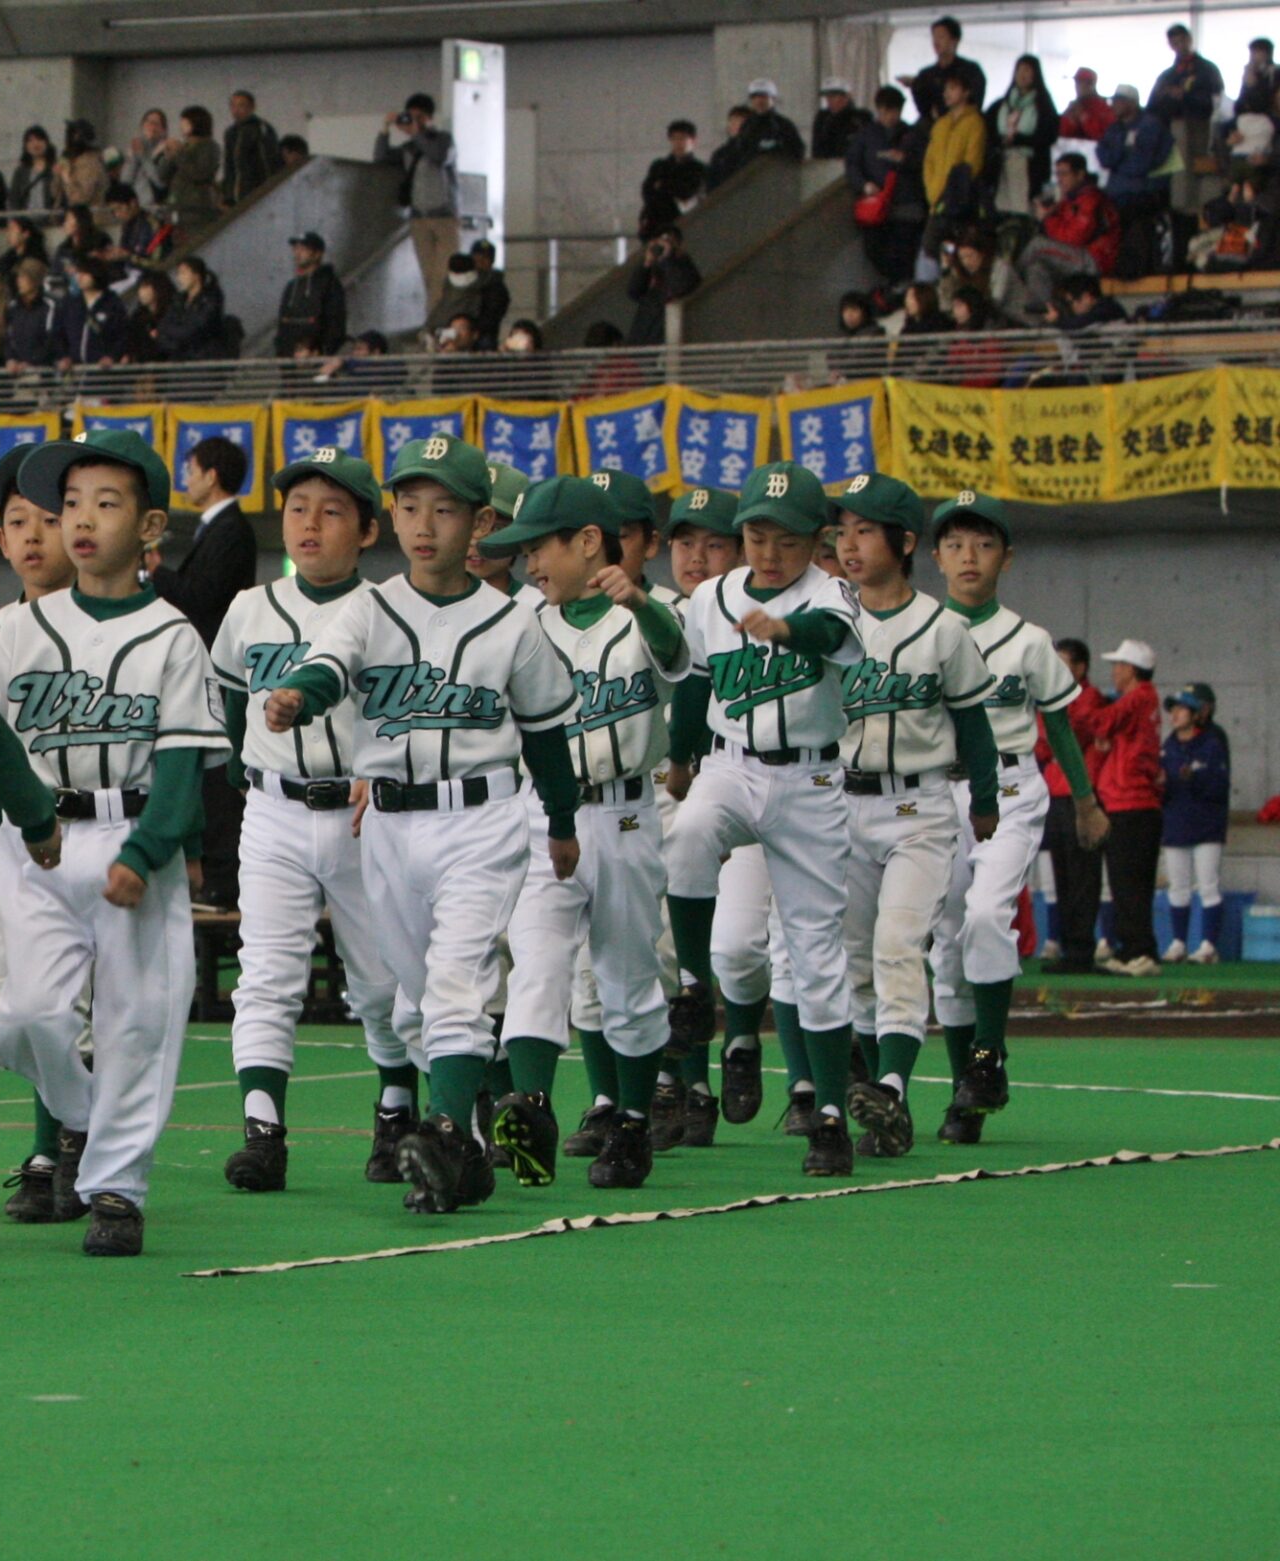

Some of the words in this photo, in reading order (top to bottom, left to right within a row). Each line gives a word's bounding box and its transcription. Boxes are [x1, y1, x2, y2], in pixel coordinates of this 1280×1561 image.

[687, 417, 747, 450] 交通
[1010, 432, 1104, 465] 交通安全
[1123, 416, 1215, 458] 交通安全
[1232, 412, 1280, 447] 交通
[681, 450, 746, 485] 安全
[7, 670, 160, 733] Wins
[357, 660, 506, 720] Wins
[572, 669, 656, 718] ins
